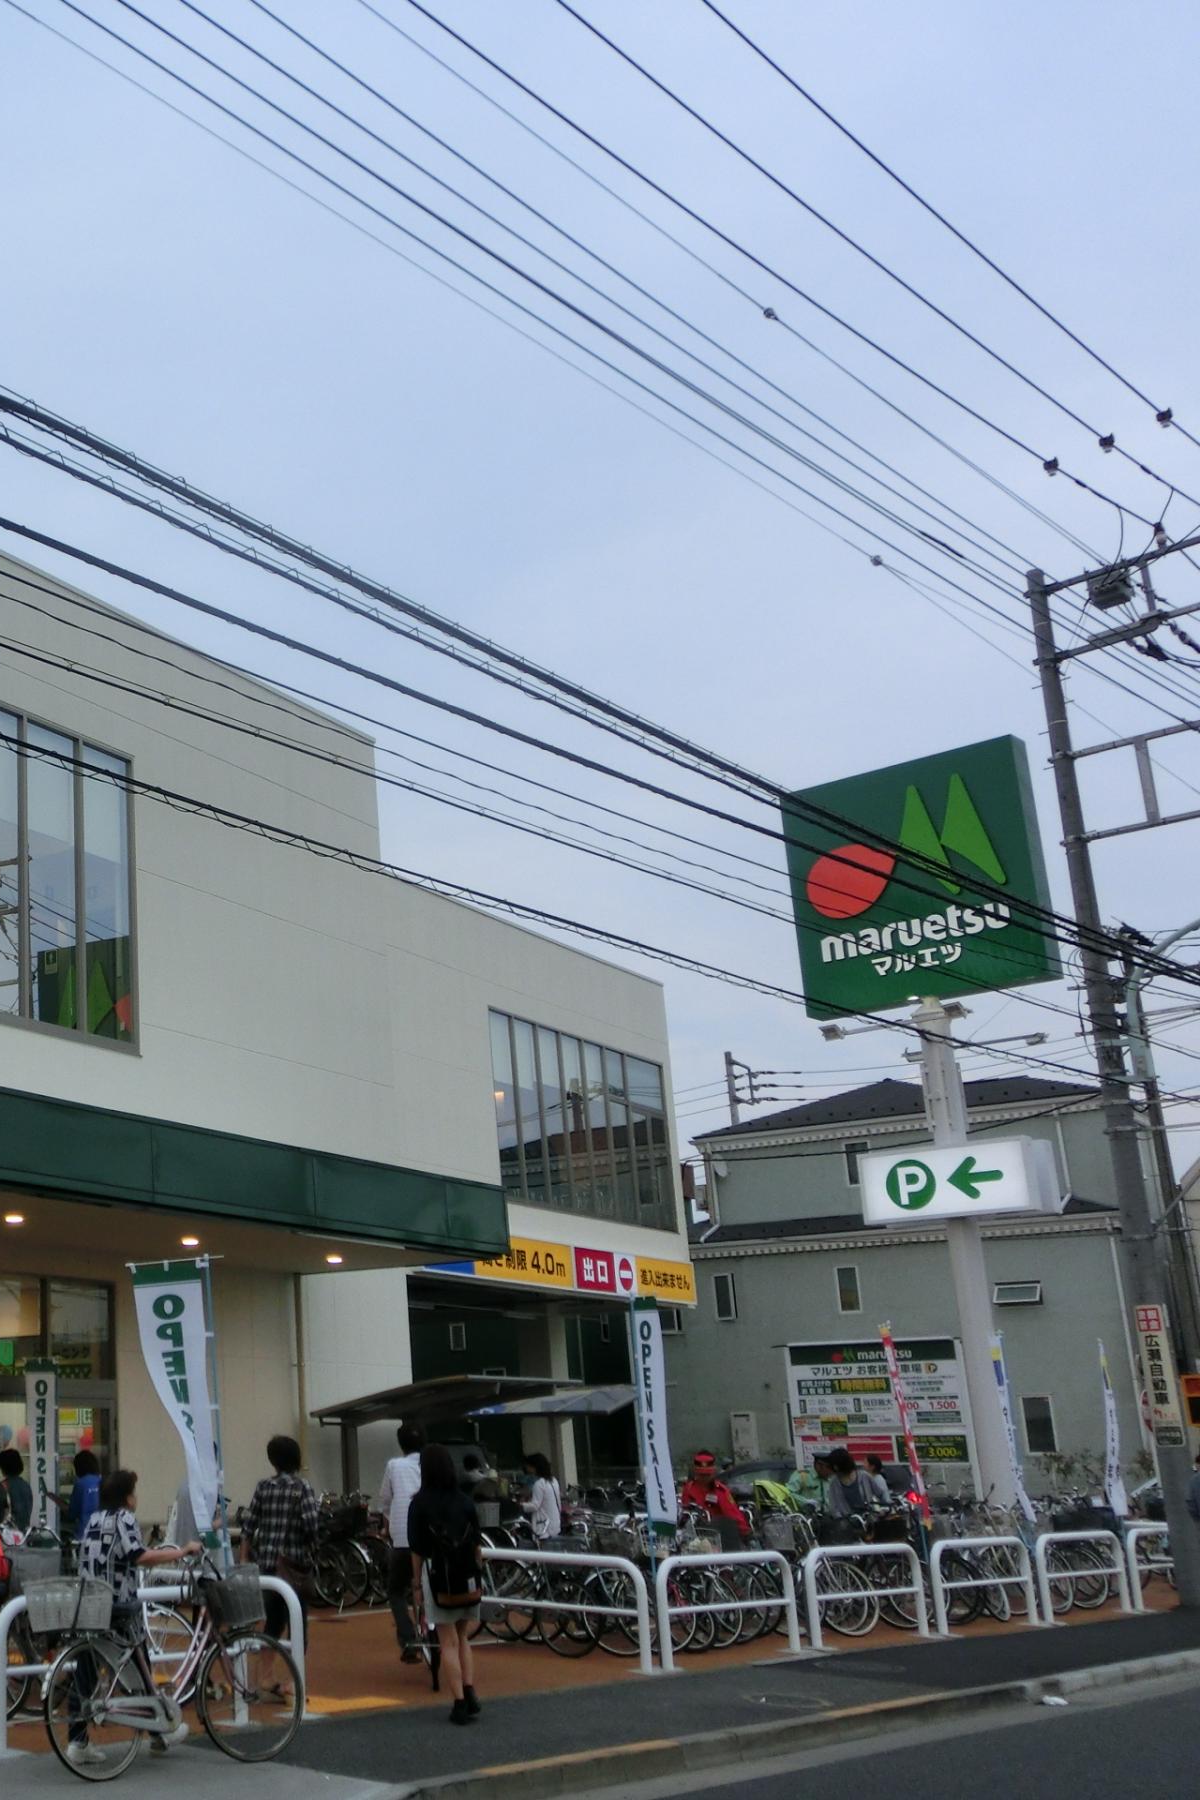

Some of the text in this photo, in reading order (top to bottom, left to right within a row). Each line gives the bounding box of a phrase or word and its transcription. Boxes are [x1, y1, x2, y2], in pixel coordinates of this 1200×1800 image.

[820, 902, 1011, 963] maruetsu
[871, 943, 962, 976] マルエツ
[531, 1251, 566, 1277] 4.0m
[582, 1257, 609, 1283] 出口
[639, 1319, 653, 1414] OPEN
[857, 1349, 912, 1360] marutsu
[856, 1362, 922, 1375] お客様車場
